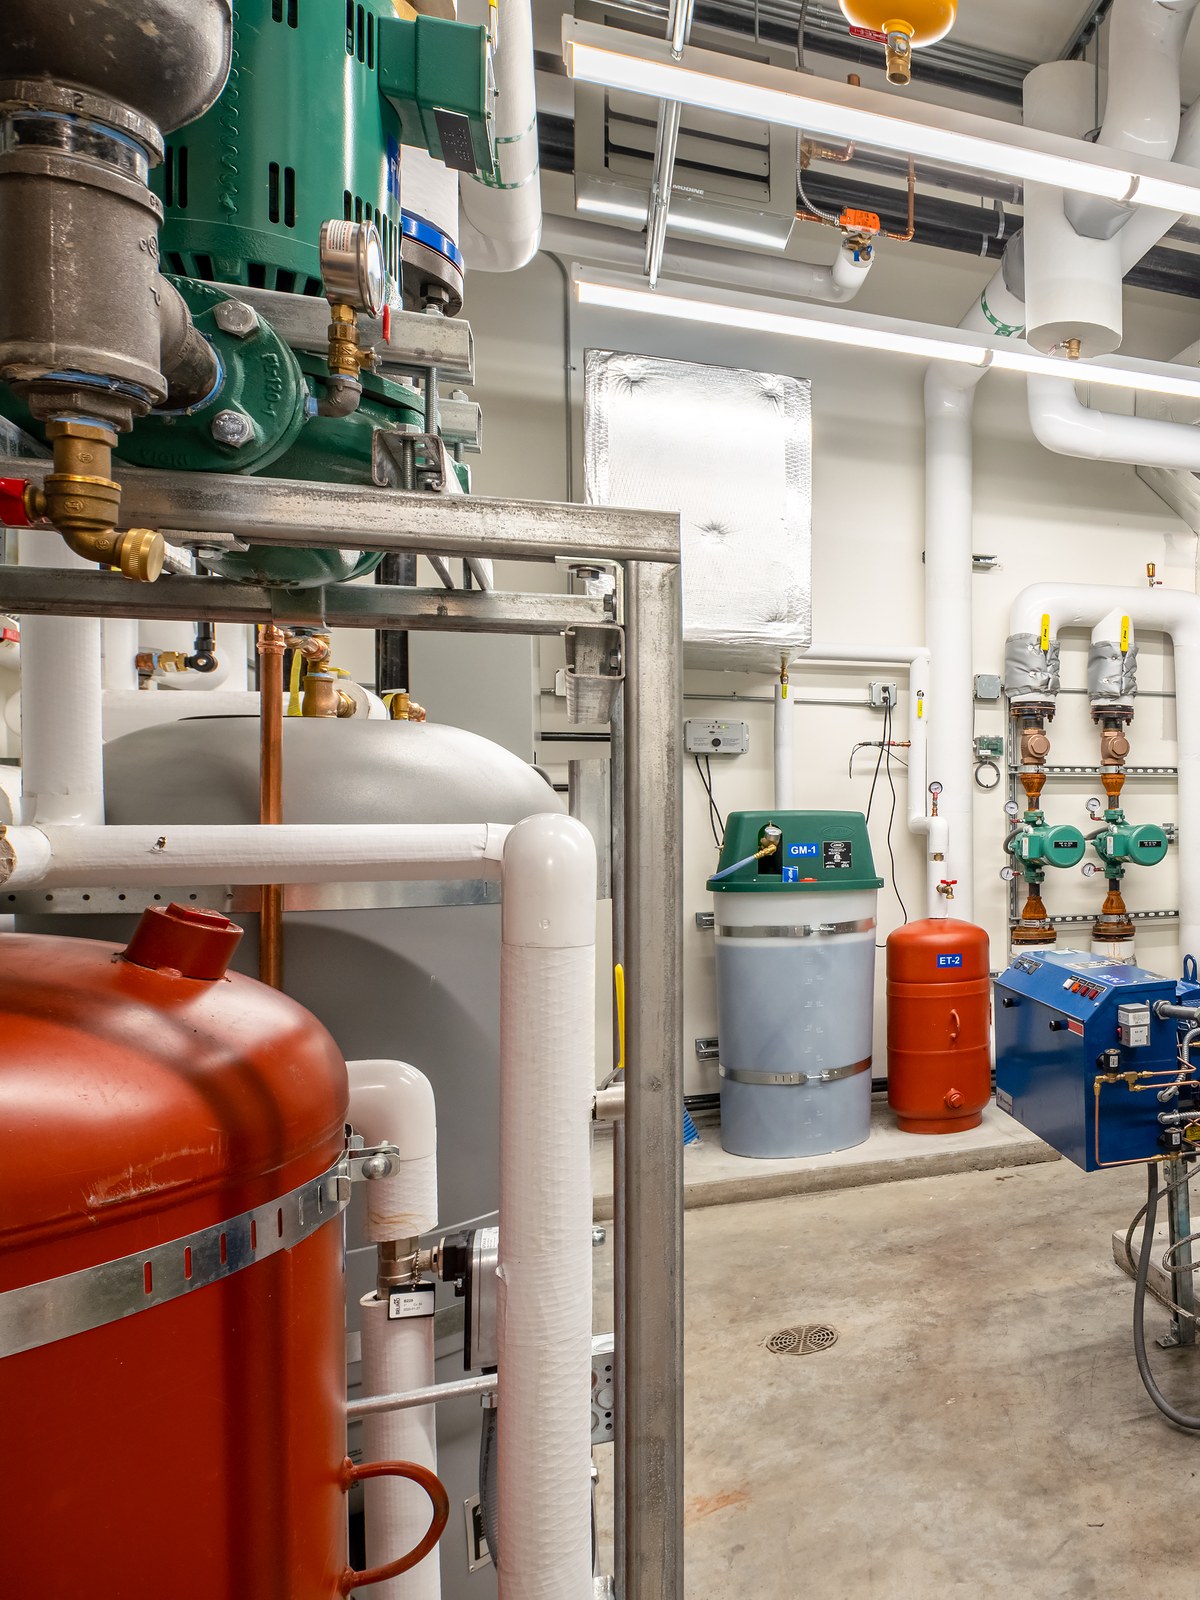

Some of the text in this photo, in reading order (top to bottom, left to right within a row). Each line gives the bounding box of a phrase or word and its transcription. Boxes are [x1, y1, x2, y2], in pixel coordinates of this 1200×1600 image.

[672, 184, 705, 195] MODINE
[790, 845, 816, 855] GM-1
[939, 956, 960, 965] ET-2
